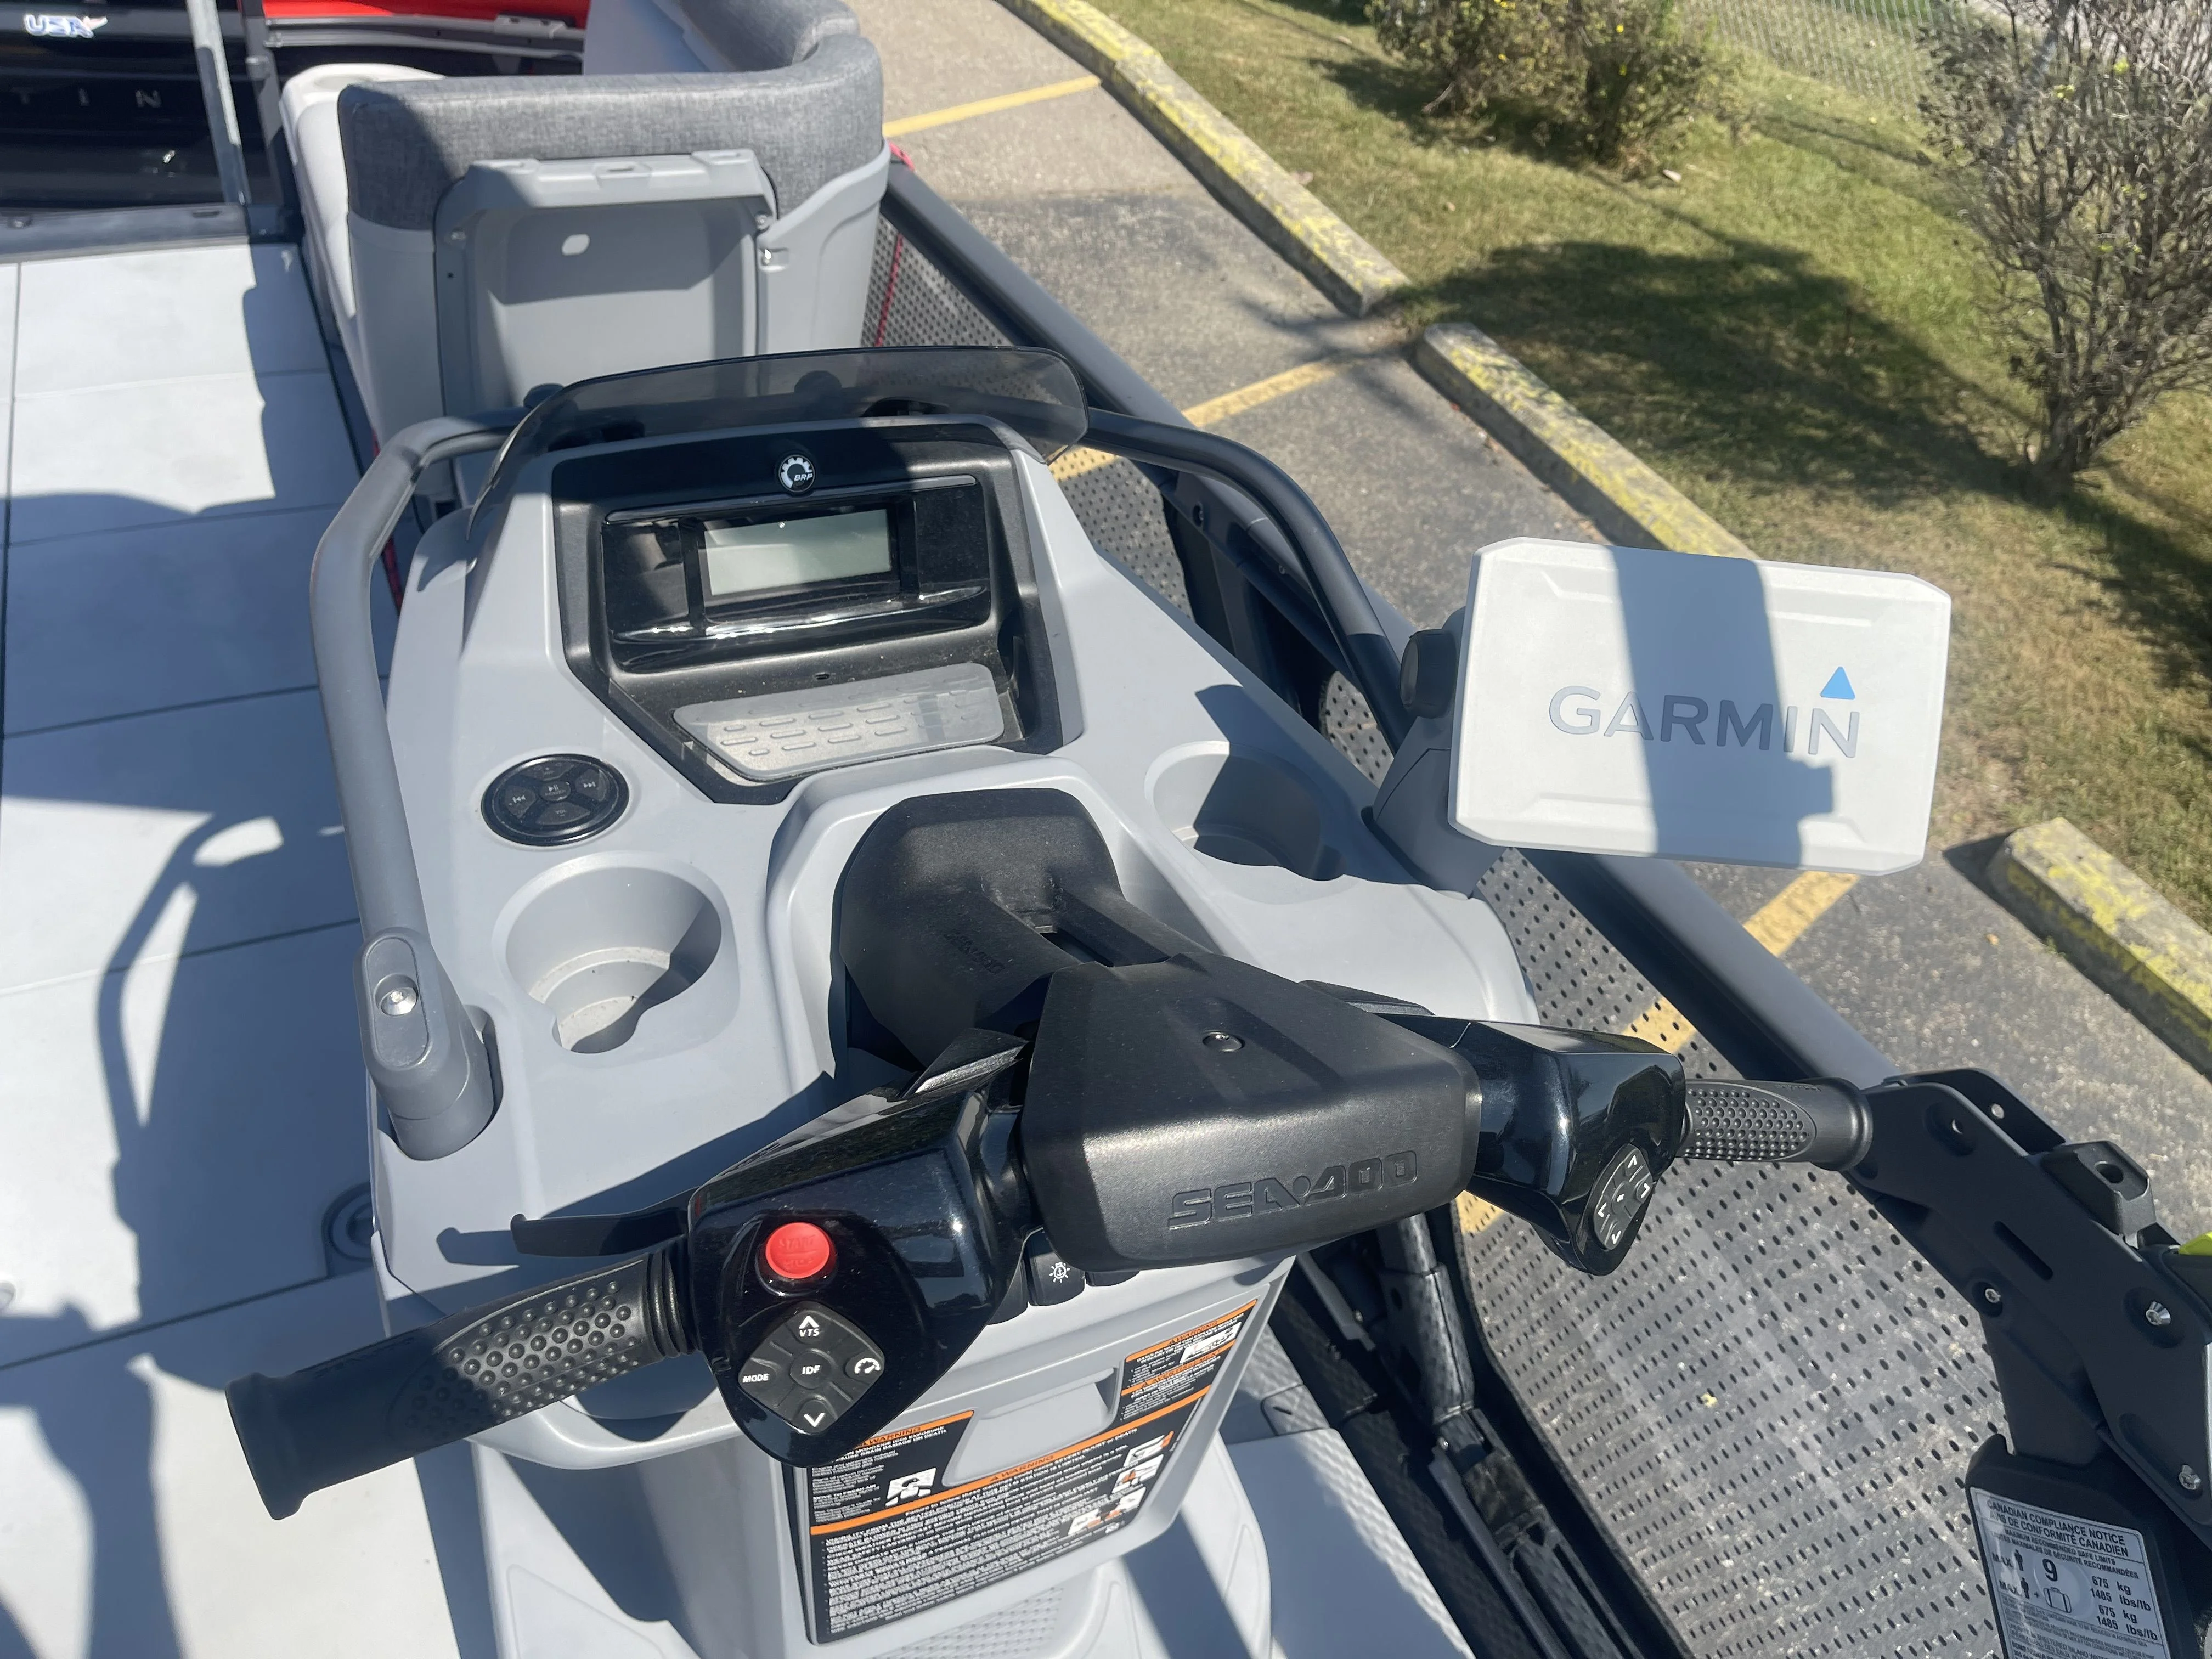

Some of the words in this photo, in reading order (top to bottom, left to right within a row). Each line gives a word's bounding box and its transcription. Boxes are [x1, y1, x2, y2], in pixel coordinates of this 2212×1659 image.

[794, 473, 813, 481] BRP
[1549, 685, 1860, 758] GARMIN
[799, 1328, 820, 1338] VTS
[742, 1373, 770, 1383] MODE
[802, 1364, 821, 1375] IDF
[869, 1426, 921, 1444] WARNING
[1001, 1455, 1054, 1477] WARNING
[1987, 1499, 2028, 1520] CANADIAN
[2029, 1514, 2086, 1536] COMPLIANCE
[2089, 1527, 2126, 1545] NOTICE
[2008, 1515, 2019, 1527] DE
[2021, 1520, 2078, 1545] CONFORMITÉ
[2079, 1536, 2129, 1558] CANADIEN
[2031, 1534, 2076, 1555] RECOMMENDED
[2077, 1548, 2094, 1560] SAFE
[2094, 1553, 2117, 1566] LIMITS
[2042, 1558, 2058, 1582] 9
[2084, 1559, 2139, 1579] RECOMMANDÉES
[2092, 1576, 2109, 1589] 675
[2116, 1581, 2131, 1596] kg
[2090, 1588, 2112, 1602] 1485
[2119, 1595, 2152, 1612] lbs/lb
[2098, 1605, 2116, 1618] 675
[2122, 1609, 2138, 1624] kg
[2096, 1616, 2119, 1630] 1485
[2126, 1623, 2158, 1641] lbs/lb
